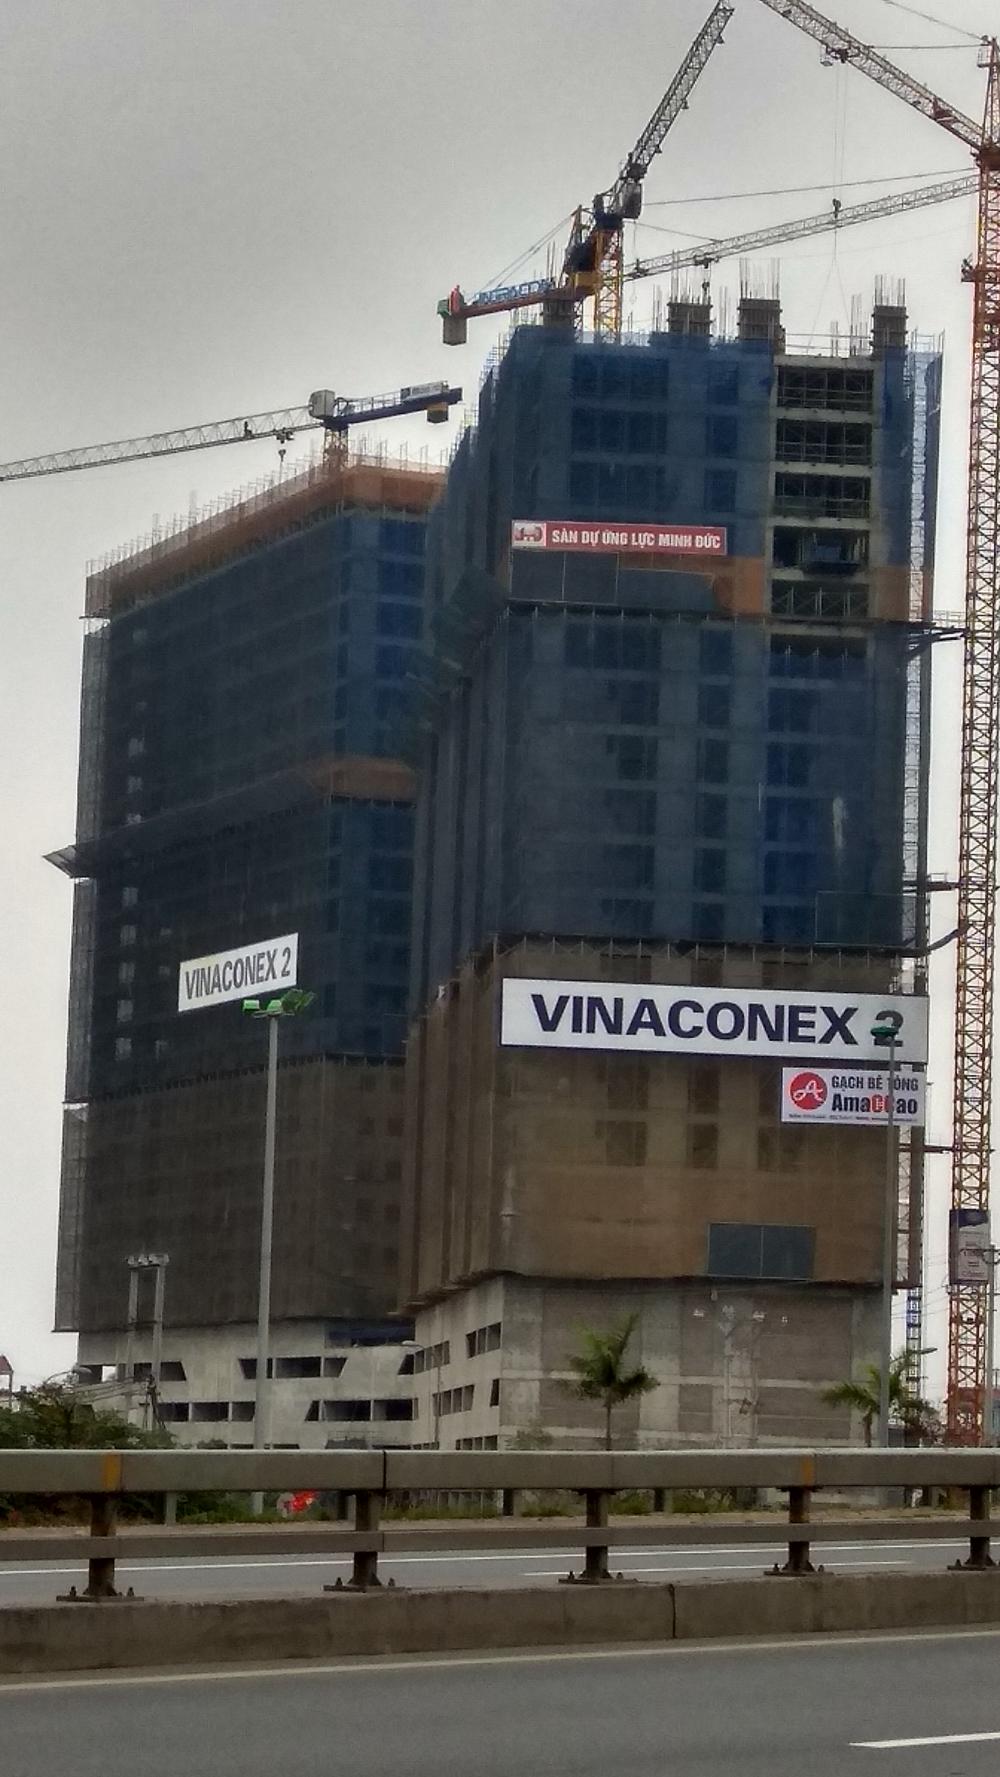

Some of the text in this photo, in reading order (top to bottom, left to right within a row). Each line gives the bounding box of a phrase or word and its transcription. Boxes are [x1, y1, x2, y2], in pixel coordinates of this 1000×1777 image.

[552, 528, 578, 544] SÀN
[581, 529, 600, 547] DỰ
[602, 529, 628, 545] ỨNG
[631, 532, 655, 548] LỰC
[658, 533, 692, 547] MINH
[695, 532, 721, 549] ĐỨC
[185, 946, 291, 1000] VINACONEX 2
[531, 993, 904, 1047] VINACONEX 2
[831, 1075, 864, 1092] GẠCH
[868, 1074, 883, 1089] BÊ
